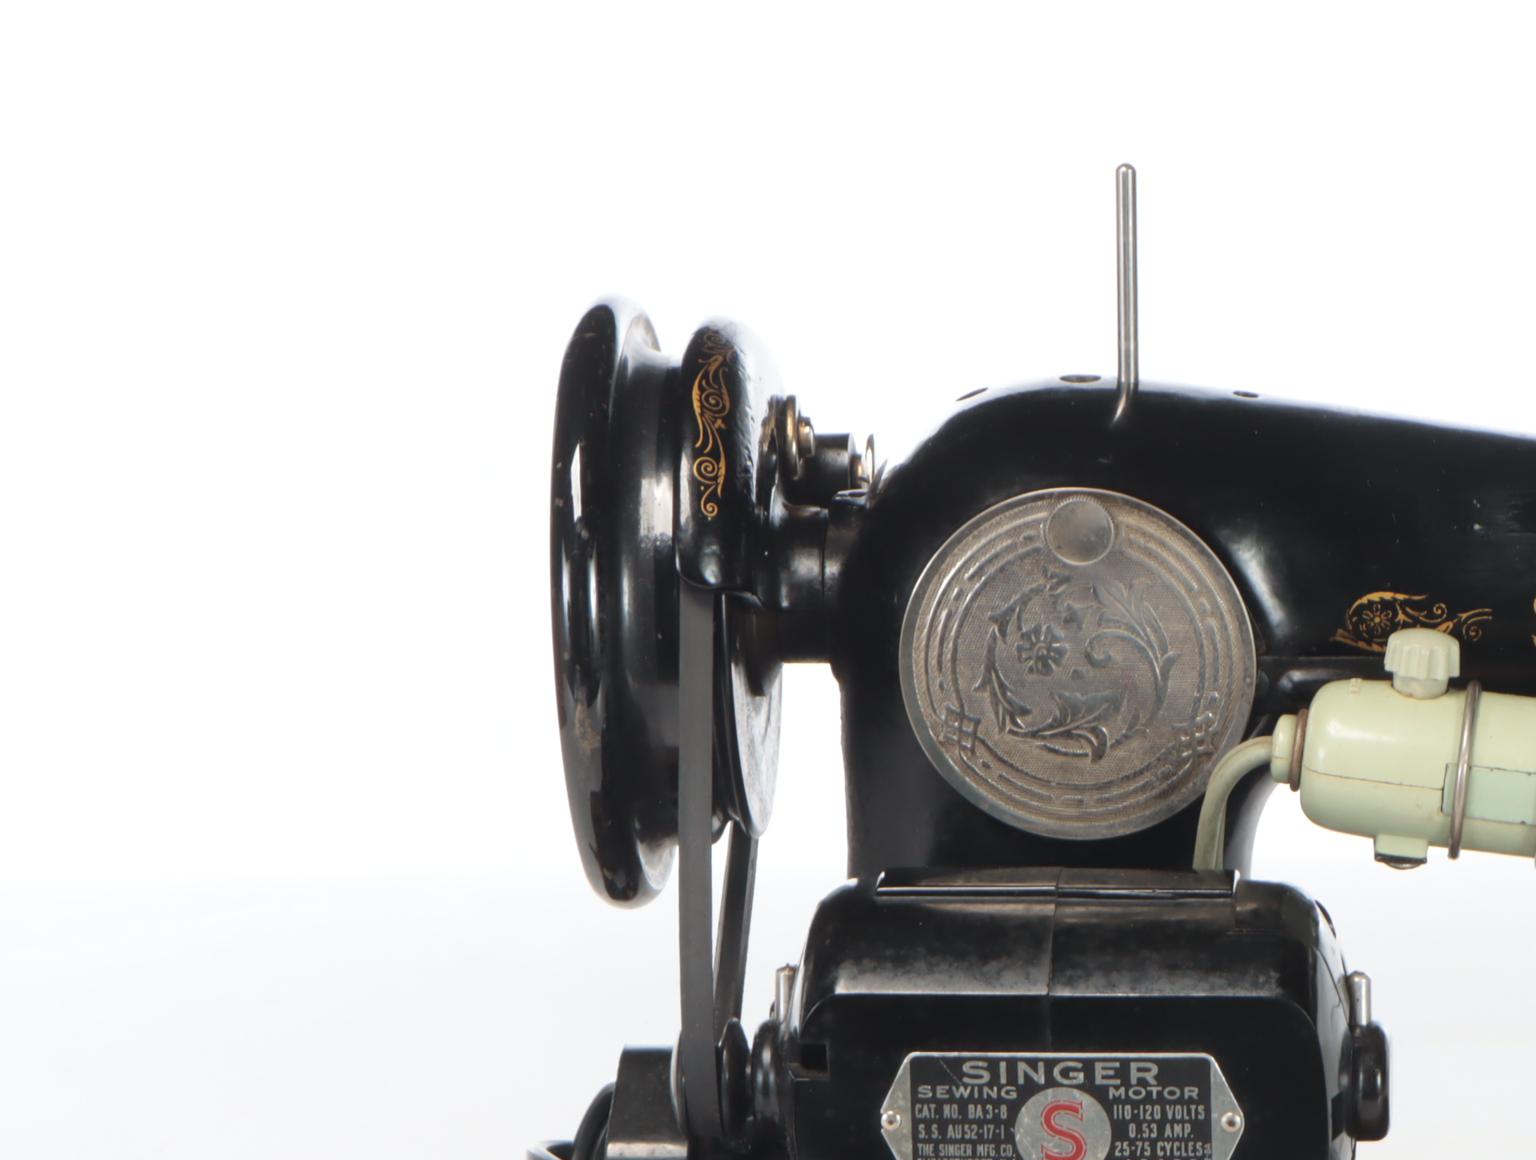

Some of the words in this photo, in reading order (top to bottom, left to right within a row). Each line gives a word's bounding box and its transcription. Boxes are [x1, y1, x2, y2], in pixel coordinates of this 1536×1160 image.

[961, 1060, 1159, 1085] SINGER
[917, 1085, 1018, 1099] SEWING
[1109, 1086, 1199, 1100] MOTOR
[915, 1104, 939, 1119] CAT.
[943, 1104, 962, 1119] NO.
[1113, 1105, 1161, 1119] 110-120
[1166, 1105, 1205, 1119] VOLTS
[1129, 1124, 1158, 1138] 0.53
[1164, 1124, 1194, 1138] AMP.
[917, 1144, 935, 1156] THE
[939, 1144, 973, 1156] SINGER
[976, 1144, 998, 1157] MFG.
[1115, 1142, 1151, 1156] 25-75
[1156, 1142, 1203, 1156] CYCLES
